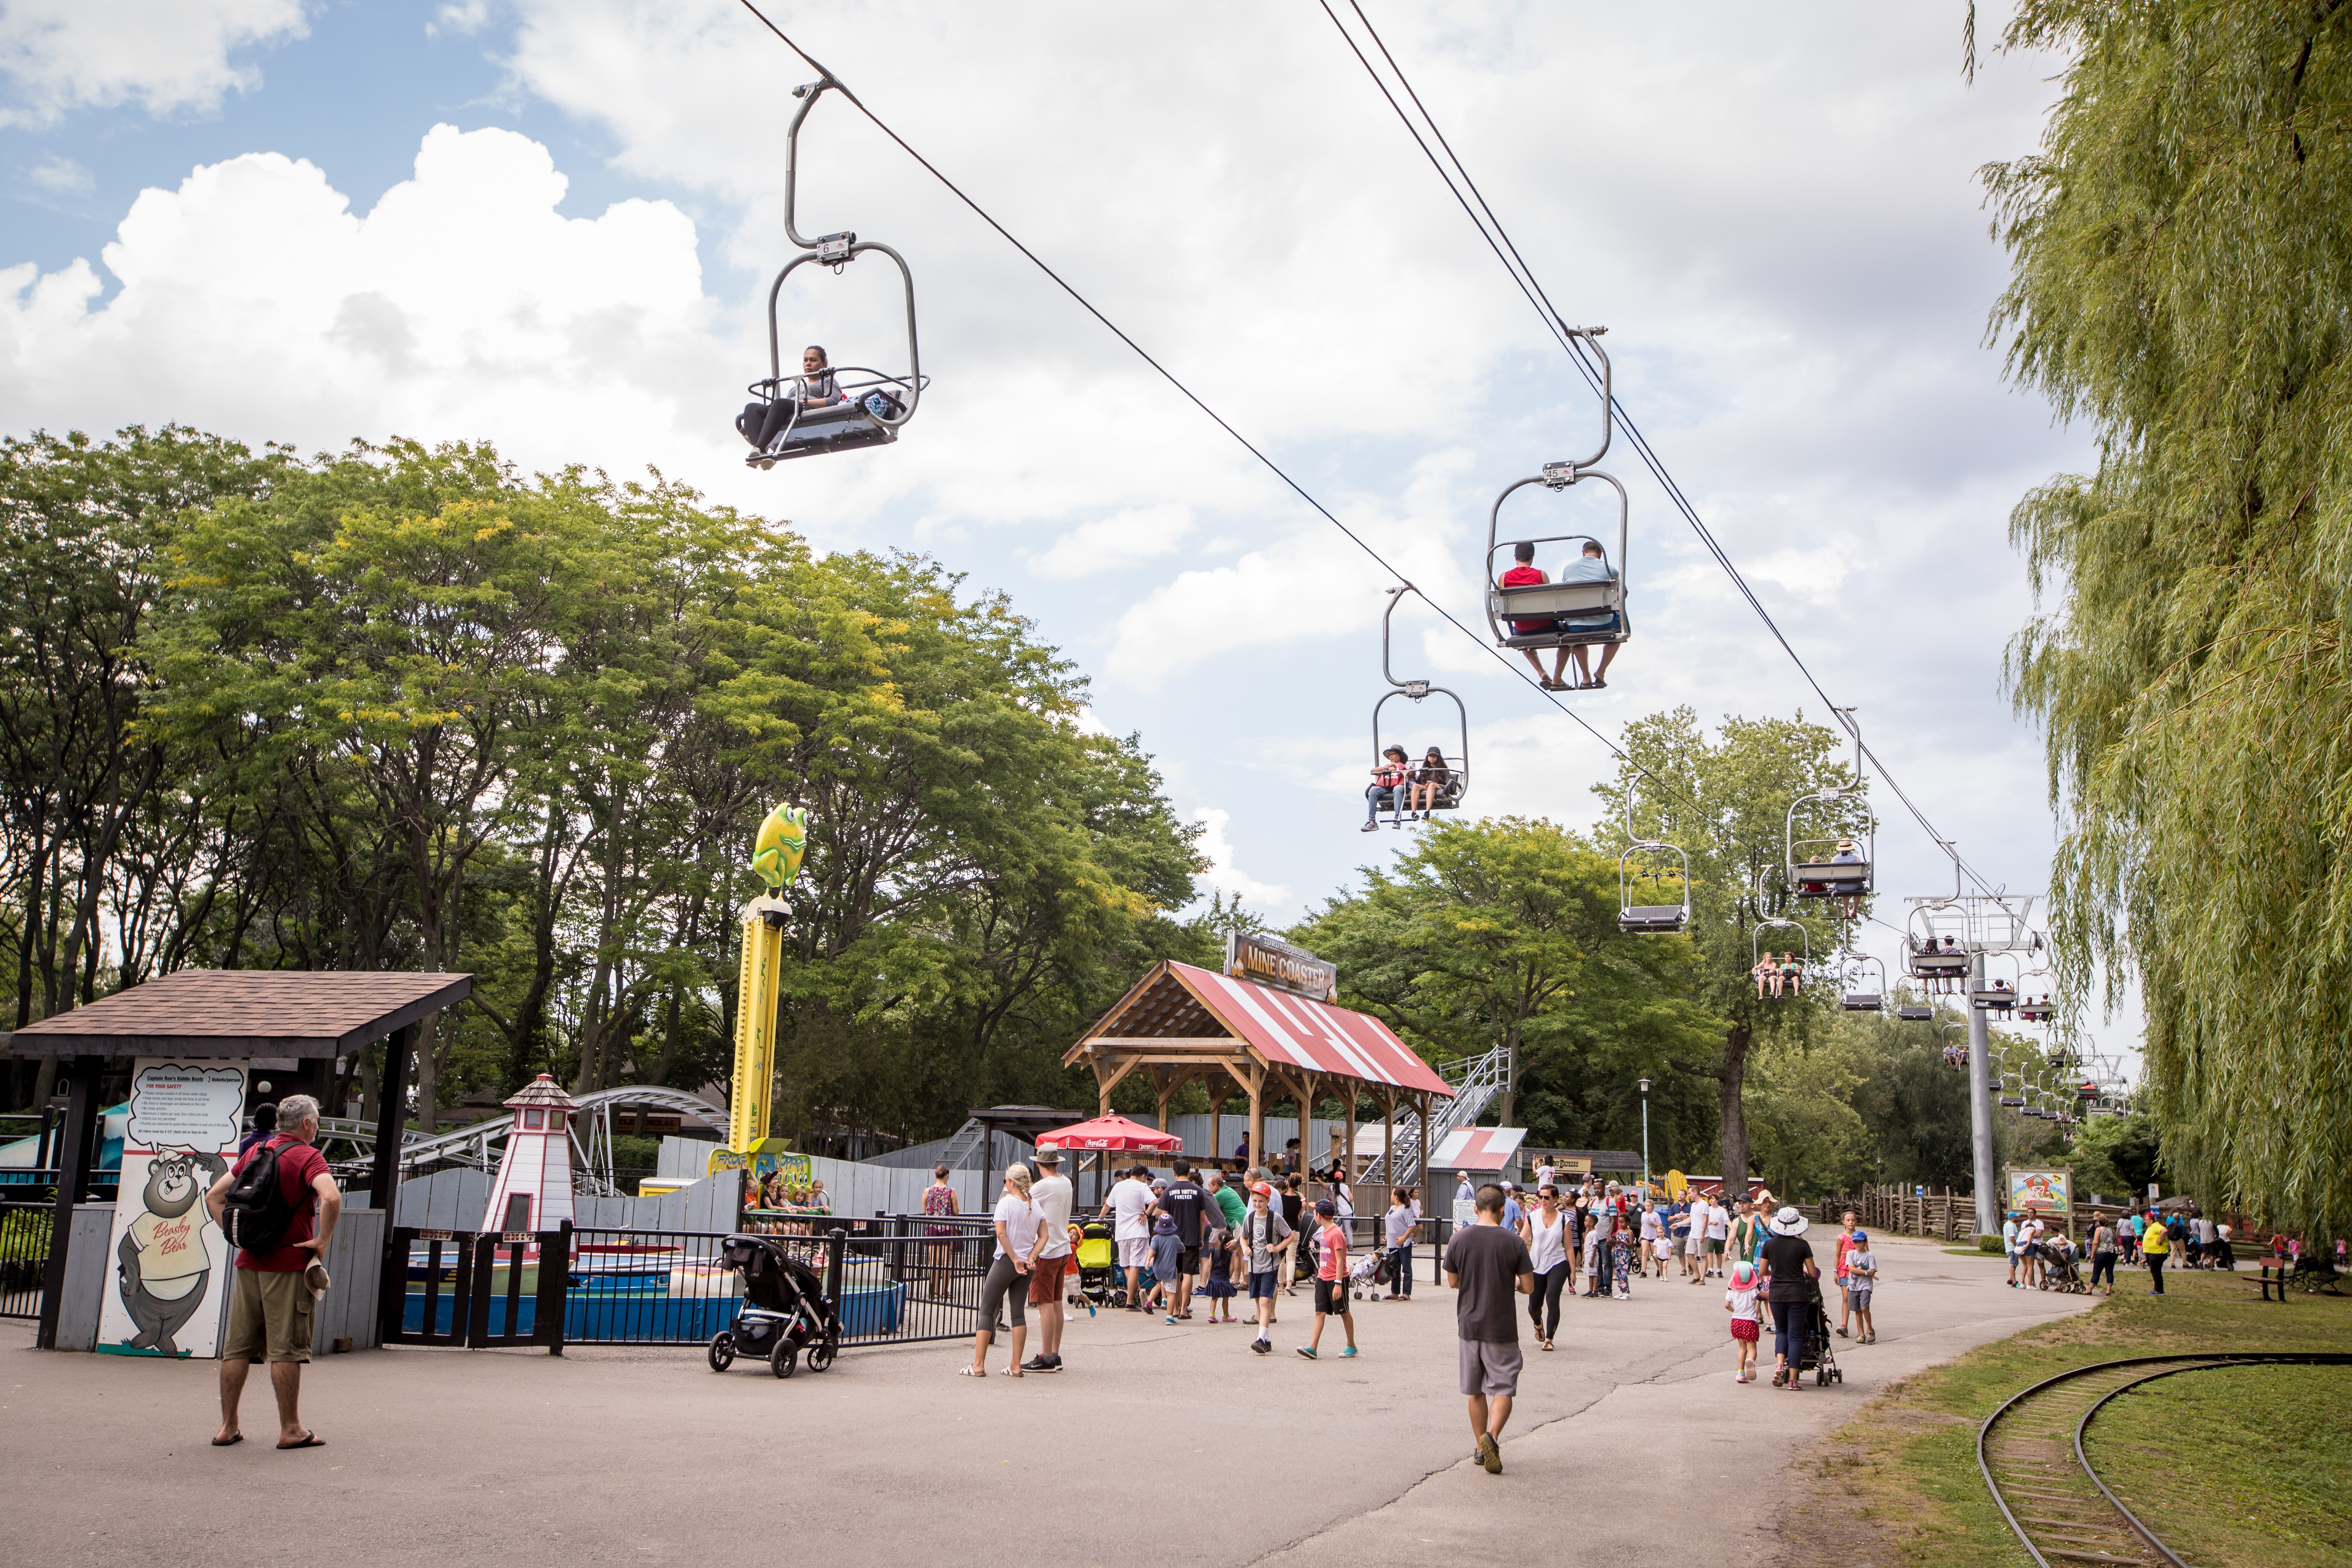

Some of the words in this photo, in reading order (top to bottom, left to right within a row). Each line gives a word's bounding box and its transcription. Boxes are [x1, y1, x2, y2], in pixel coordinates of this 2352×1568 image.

[823, 244, 829, 253] 6
[1263, 937, 1291, 952] TORONTO
[1292, 946, 1313, 960] ISLAND
[1248, 945, 1276, 976] MINE
[1279, 958, 1325, 991] COASTER
[718, 1153, 747, 1165] FROG
[1559, 1159, 1579, 1168] EXPRESS
[153, 1216, 190, 1244] Beasley
[421, 1230, 452, 1239] EXIT
[161, 1237, 188, 1256] Bear
